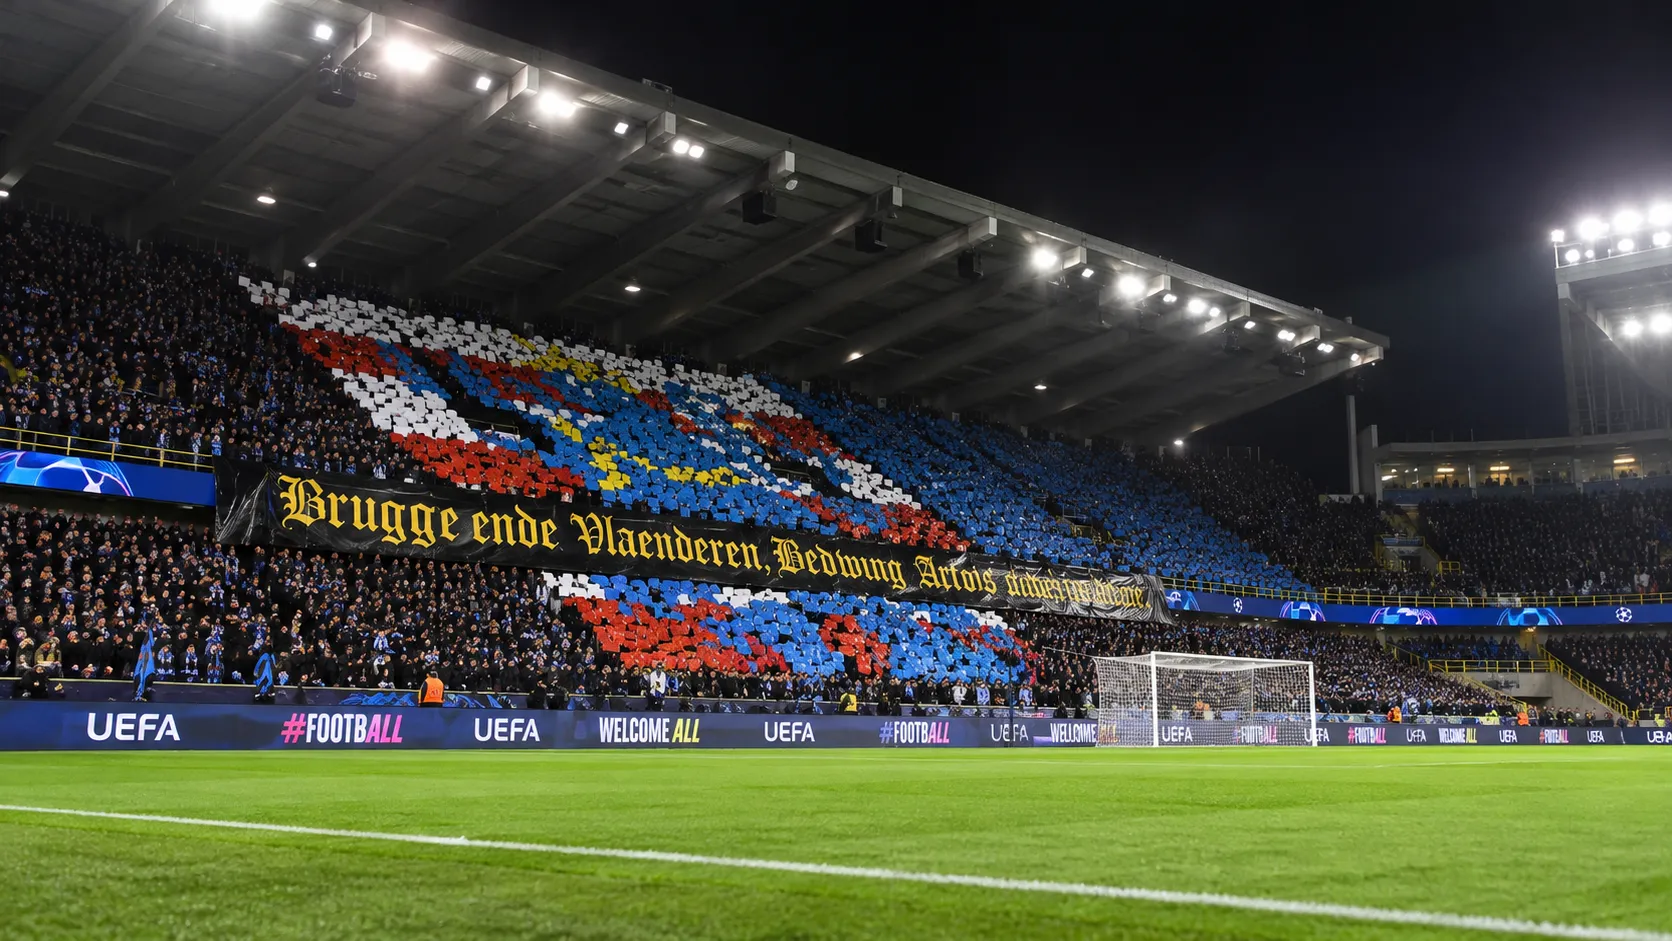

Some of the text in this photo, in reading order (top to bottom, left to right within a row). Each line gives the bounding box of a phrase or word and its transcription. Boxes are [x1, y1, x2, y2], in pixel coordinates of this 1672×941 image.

[278, 473, 459, 549] Brugge
[471, 504, 562, 550] ende
[914, 555, 998, 596] Artois
[87, 712, 181, 742] UEFA
[281, 712, 403, 744] #FOOTBALL
[474, 718, 540, 743] UEFA
[599, 717, 700, 743] WELCOME ALL
[764, 721, 816, 743] UEFA
[878, 721, 950, 745] #FOOTBALL
[990, 723, 1029, 742] UEFA
[1161, 725, 1193, 743] UEFA
[1498, 729, 1518, 743] UEFA
[1587, 730, 1605, 743] UEFA
